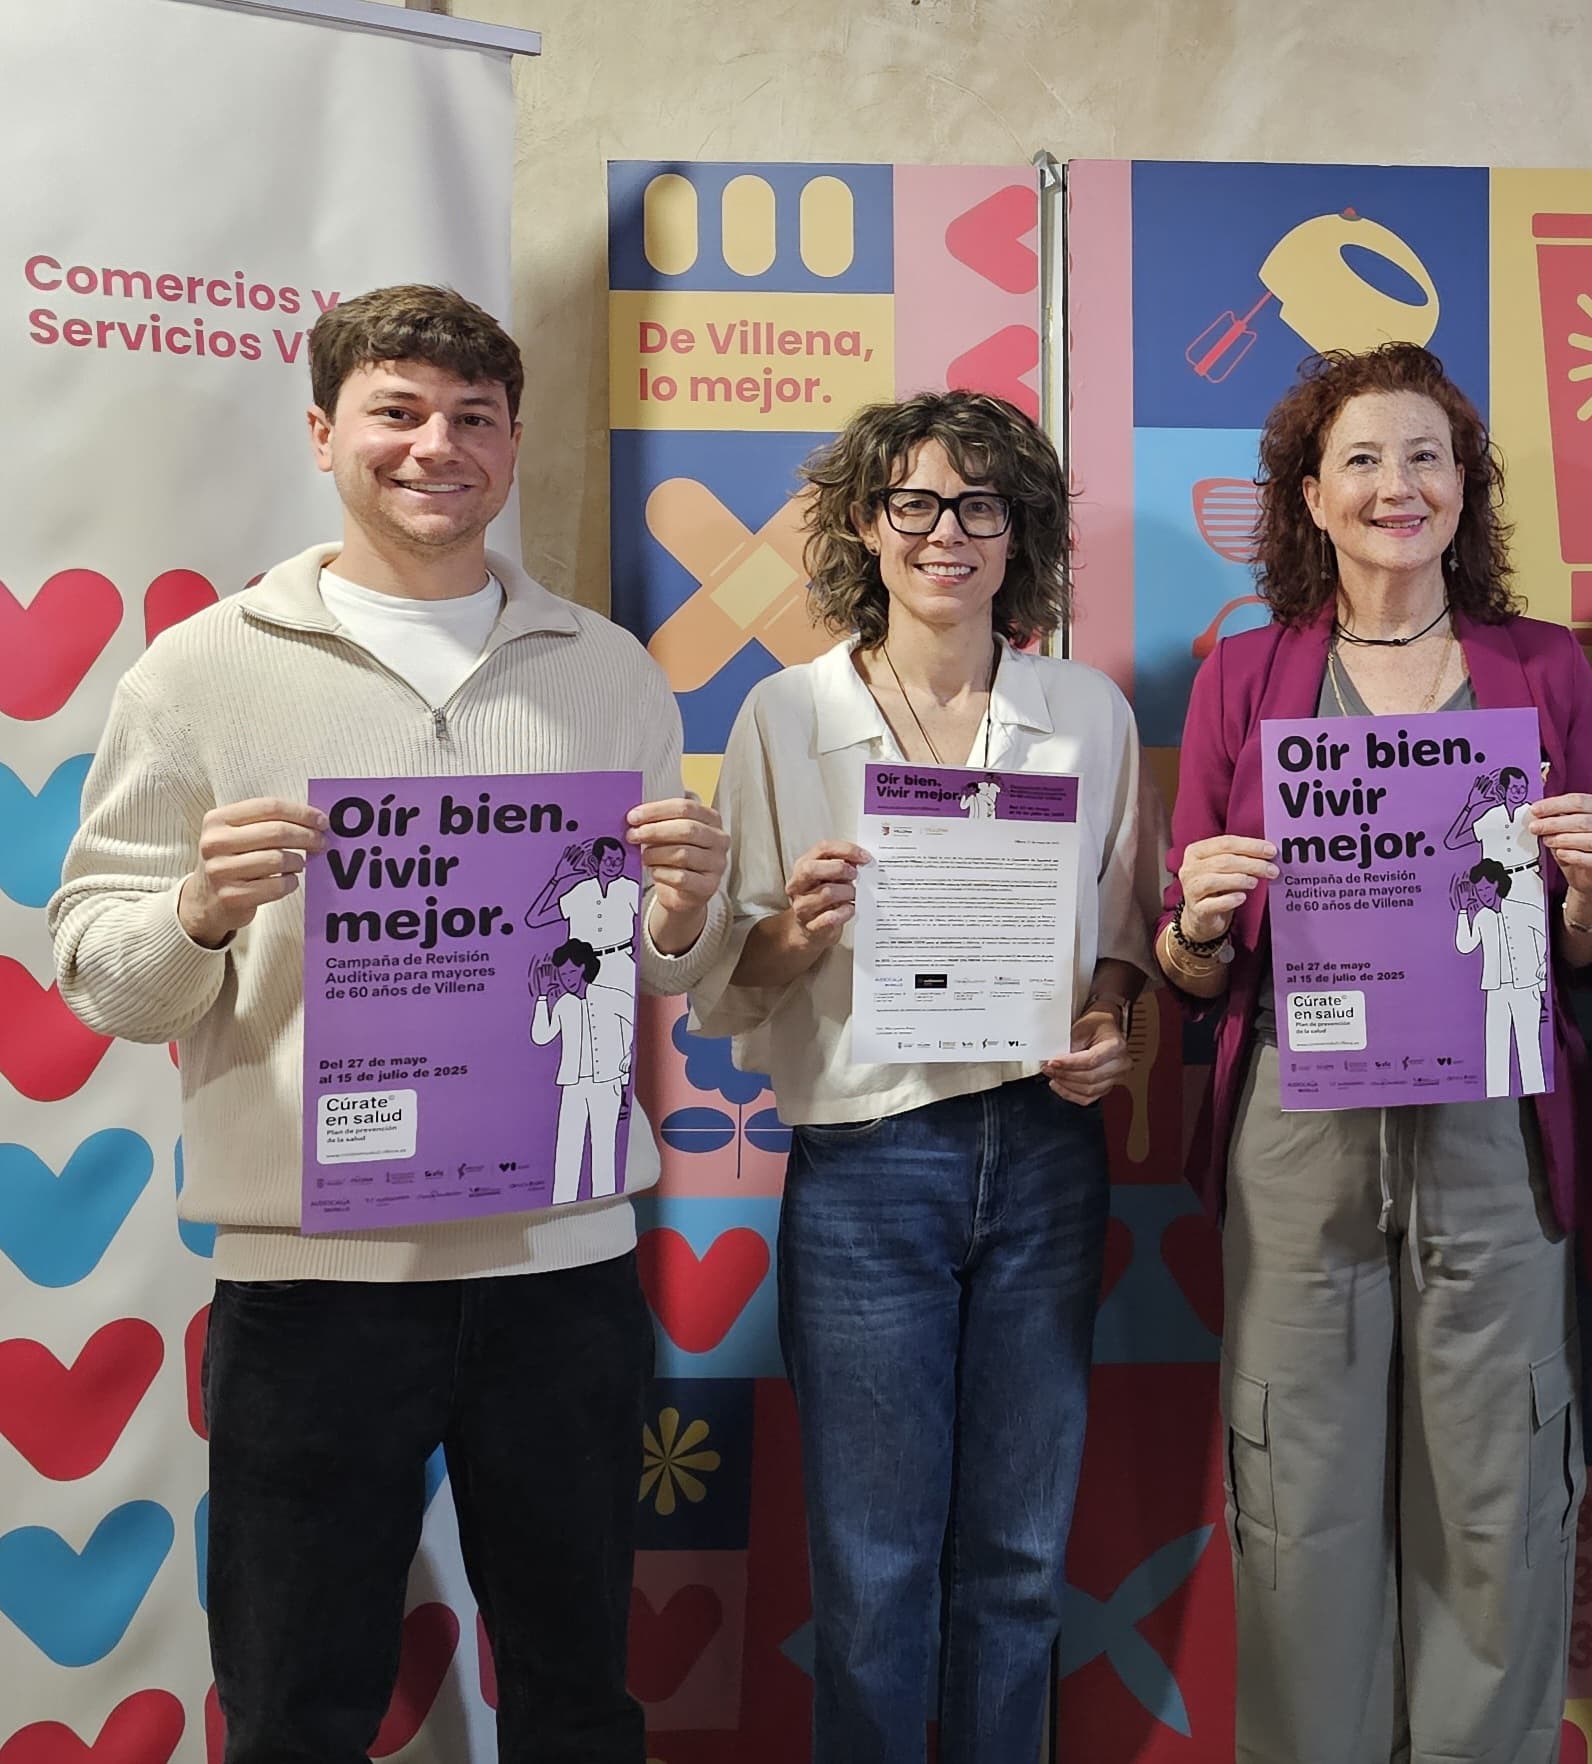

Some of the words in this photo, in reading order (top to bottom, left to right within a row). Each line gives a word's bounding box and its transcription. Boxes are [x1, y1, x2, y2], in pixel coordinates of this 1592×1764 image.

[24, 254, 301, 314] Comercios
[29, 307, 262, 361] Servicios
[639, 321, 696, 354] De
[706, 319, 874, 362] Villena,
[639, 367, 677, 401] lo
[689, 367, 832, 413] mejor.
[1278, 732, 1350, 772] Oír
[1366, 729, 1485, 769] bien.
[877, 773, 900, 784] Oír
[904, 774, 942, 787] bien.
[876, 786, 910, 798] Vivir
[914, 786, 964, 802] mejor.
[1279, 778, 1387, 818] Vivir
[329, 794, 420, 838] Oír
[439, 793, 579, 835] bien.
[1282, 823, 1435, 869] mejor.
[326, 844, 459, 890] Vivir
[1284, 874, 1343, 886] Campaña
[1345, 873, 1361, 884] de
[1364, 870, 1416, 883] Revisión
[1285, 887, 1336, 899] Auditiva
[1339, 888, 1366, 899] para
[1369, 885, 1422, 896] mayores
[1286, 900, 1302, 912] de
[1304, 901, 1319, 911] 60
[1322, 900, 1351, 911] años
[1354, 899, 1369, 910] de
[1372, 897, 1414, 909] Villena
[326, 896, 514, 949] mejor.
[326, 955, 399, 969] Campaña
[403, 953, 422, 966] de
[426, 950, 489, 964] Revisión
[1286, 962, 1304, 971] Del
[1307, 962, 1320, 971] 27
[1323, 962, 1337, 971] de
[1340, 962, 1371, 971] mayo
[325, 970, 390, 984] Auditiva
[393, 971, 428, 984] para
[432, 967, 496, 980] mayores
[1287, 975, 1297, 983] al
[1300, 974, 1312, 983] 15
[1315, 974, 1329, 983] de
[1332, 973, 1356, 984] julio
[1360, 973, 1374, 981] de
[1377, 971, 1405, 980] 2025
[325, 987, 345, 1000] de
[349, 986, 368, 998] 60
[371, 985, 408, 997] años
[411, 983, 431, 995] de
[434, 981, 485, 994] Villena
[1294, 1010, 1312, 1020] en
[1315, 1007, 1354, 1019] salud
[319, 1059, 343, 1070] Del
[348, 1058, 364, 1068] 27
[368, 1057, 385, 1067] de
[390, 1057, 427, 1067] mayo
[319, 1074, 332, 1084] al
[337, 1073, 352, 1083] 15
[357, 1072, 374, 1082] de
[378, 1069, 408, 1083] julio
[412, 1068, 430, 1078] de
[434, 1065, 468, 1077] 2025
[325, 1115, 348, 1126] en
[353, 1108, 402, 1124] salud
